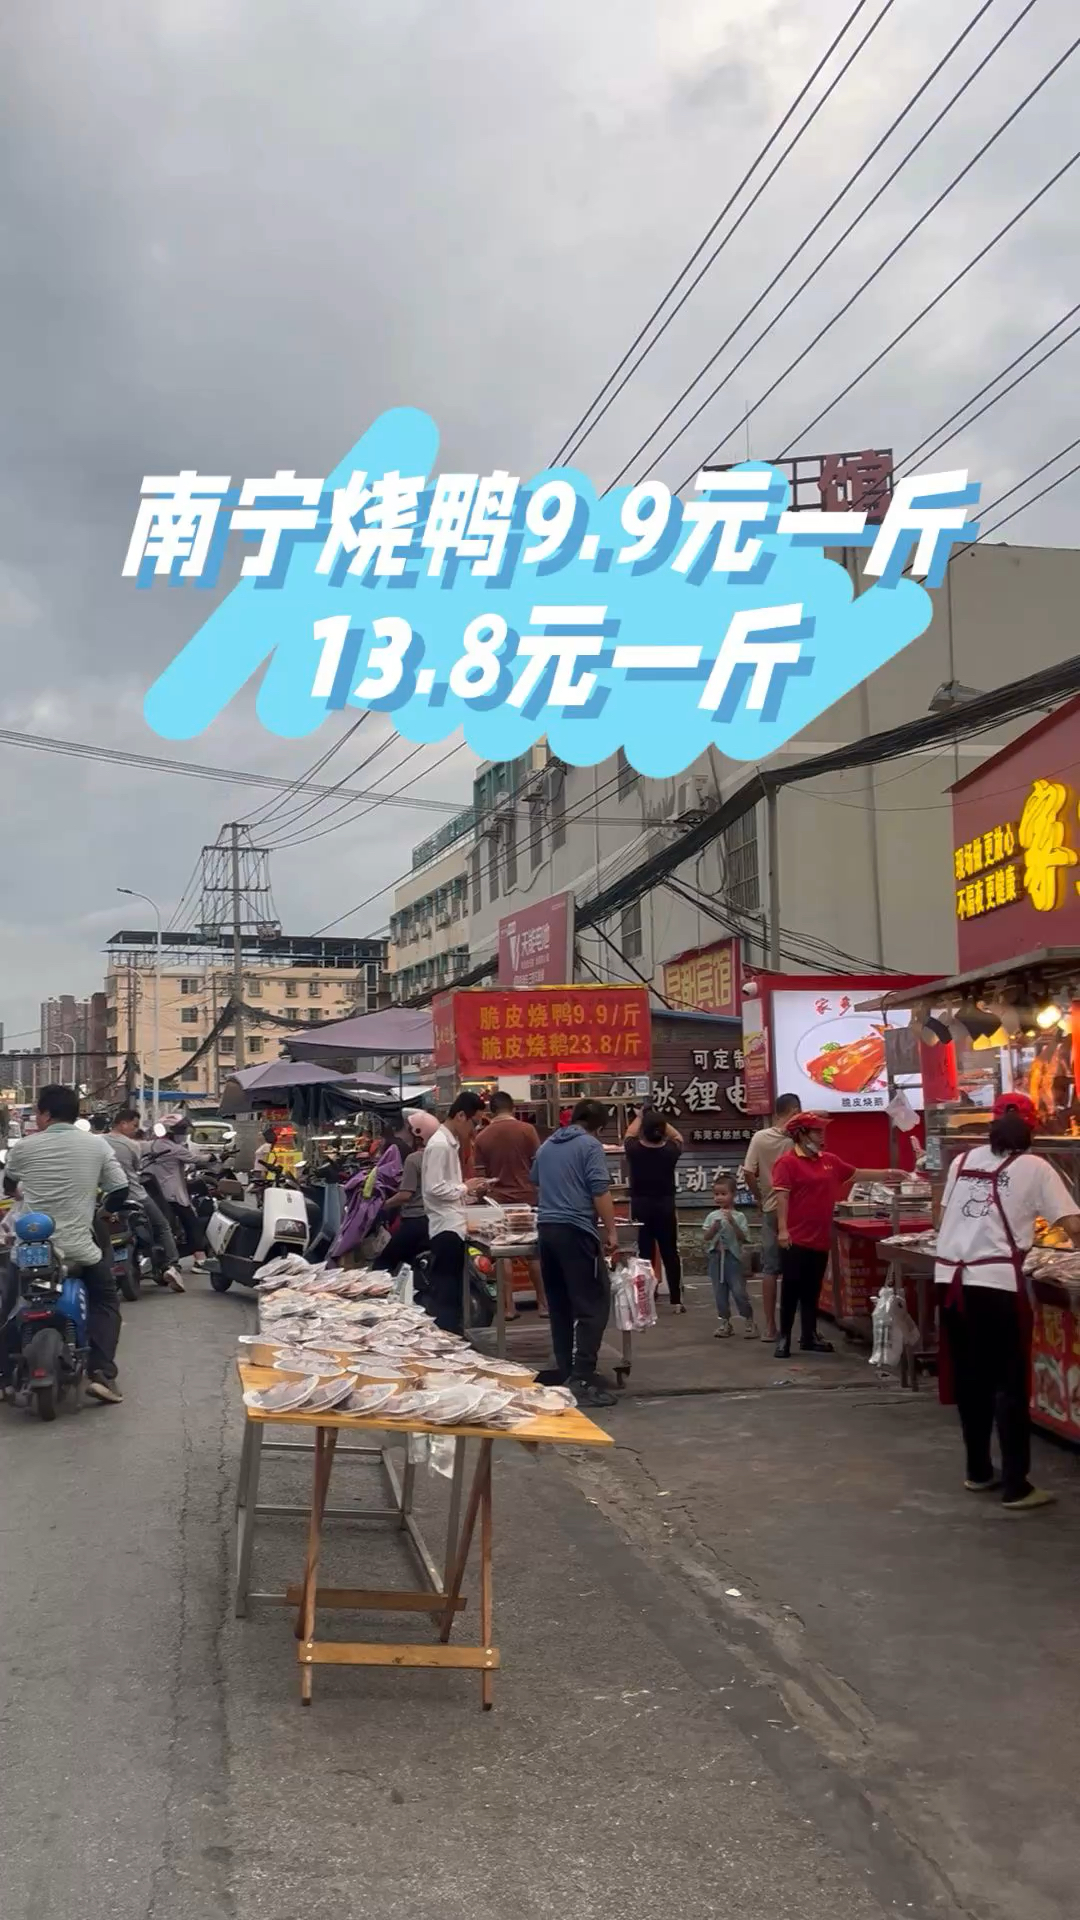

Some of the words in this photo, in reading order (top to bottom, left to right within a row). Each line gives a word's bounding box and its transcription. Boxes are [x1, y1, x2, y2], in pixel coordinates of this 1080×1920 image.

[479, 1003, 641, 1030] 脆皮烧鸭9.9/斤
[481, 1032, 642, 1060] 脆皮烧鹅23.8/斤
